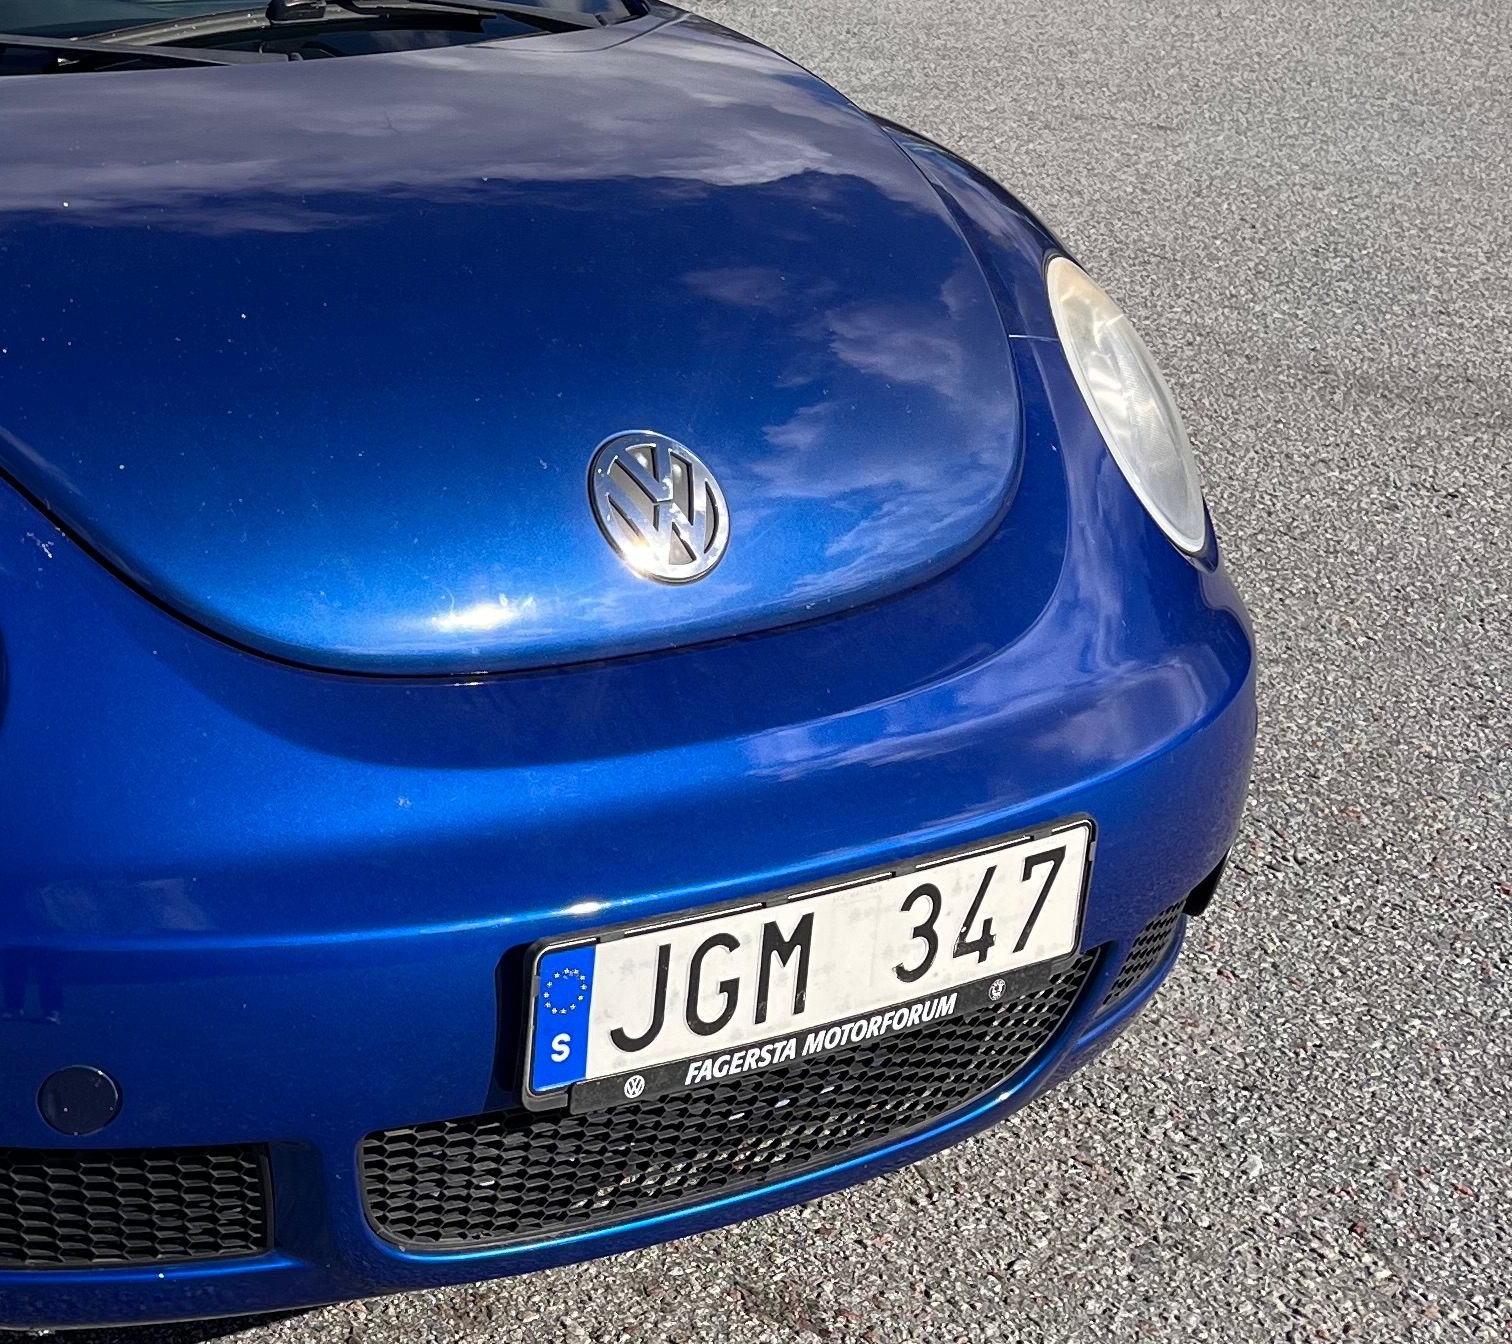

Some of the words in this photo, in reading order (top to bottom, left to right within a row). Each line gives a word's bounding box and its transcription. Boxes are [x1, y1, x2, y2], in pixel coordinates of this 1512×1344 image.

[609, 911, 815, 1053] JGM
[893, 844, 1068, 984] 347
[550, 1032, 571, 1063] S
[684, 1037, 797, 1086] FAGERSTA
[801, 992, 959, 1057] MOTORFORUM
